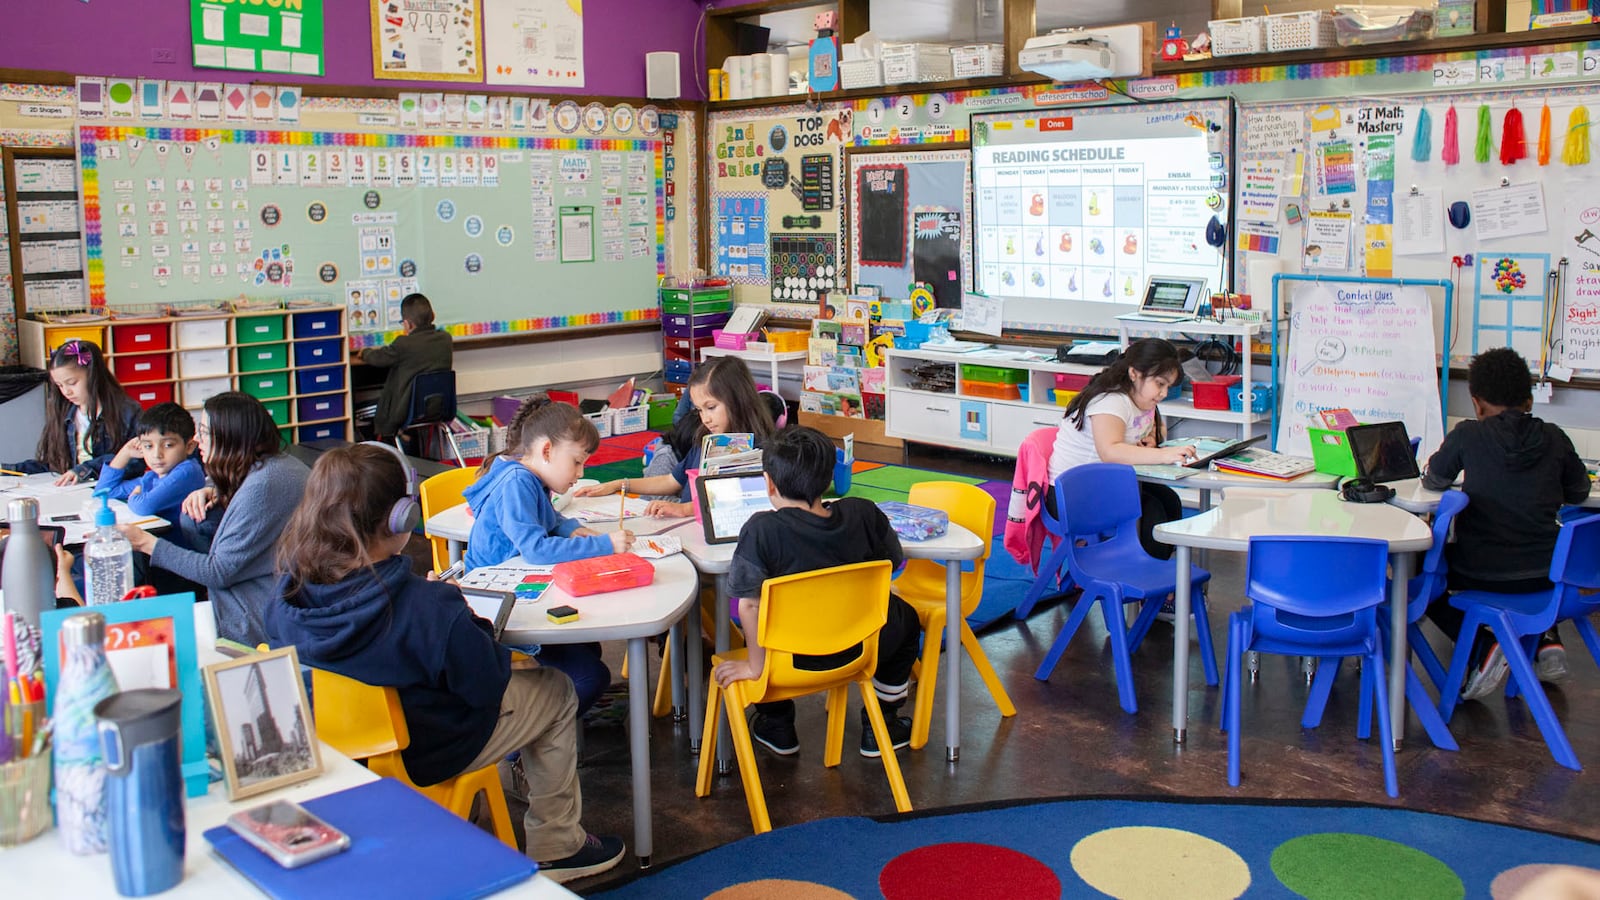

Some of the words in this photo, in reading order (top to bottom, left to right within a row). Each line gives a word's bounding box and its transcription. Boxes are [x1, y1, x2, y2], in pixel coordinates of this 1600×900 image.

[1583, 56, 1597, 71] D
[1433, 68, 1444, 81] P
[1480, 65, 1492, 80] R
[1037, 88, 1107, 102] safesearch.school
[1131, 83, 1175, 94] kidrex.org
[873, 108, 878, 118] 1
[902, 105, 909, 115] 2
[933, 103, 940, 113] 3
[1375, 106, 1404, 119] Math
[796, 117, 823, 132] TOP
[1047, 120, 1065, 128] Ones
[1357, 120, 1403, 136] Mastery
[726, 123, 754, 142] 2nd
[794, 133, 824, 147] DOGS
[716, 140, 764, 159] Grade
[992, 150, 1050, 164] READING
[1052, 147, 1125, 162] SCHEDULE
[284, 154, 289, 166] 1
[307, 153, 317, 167] 2
[331, 154, 340, 167] 3
[355, 155, 363, 167] 4
[378, 155, 387, 168] 5
[401, 156, 409, 168] 6
[423, 155, 431, 167] 7
[466, 156, 474, 168] 9
[484, 157, 496, 169] 10
[562, 157, 587, 168] MATH
[664, 134, 675, 218] READING
[1576, 275, 1600, 285] stra
[1337, 289, 1372, 301] Context
[1374, 288, 1393, 301] Clues
[1334, 304, 1352, 313] that
[1568, 307, 1598, 321] Sight
[1568, 350, 1585, 361] old
